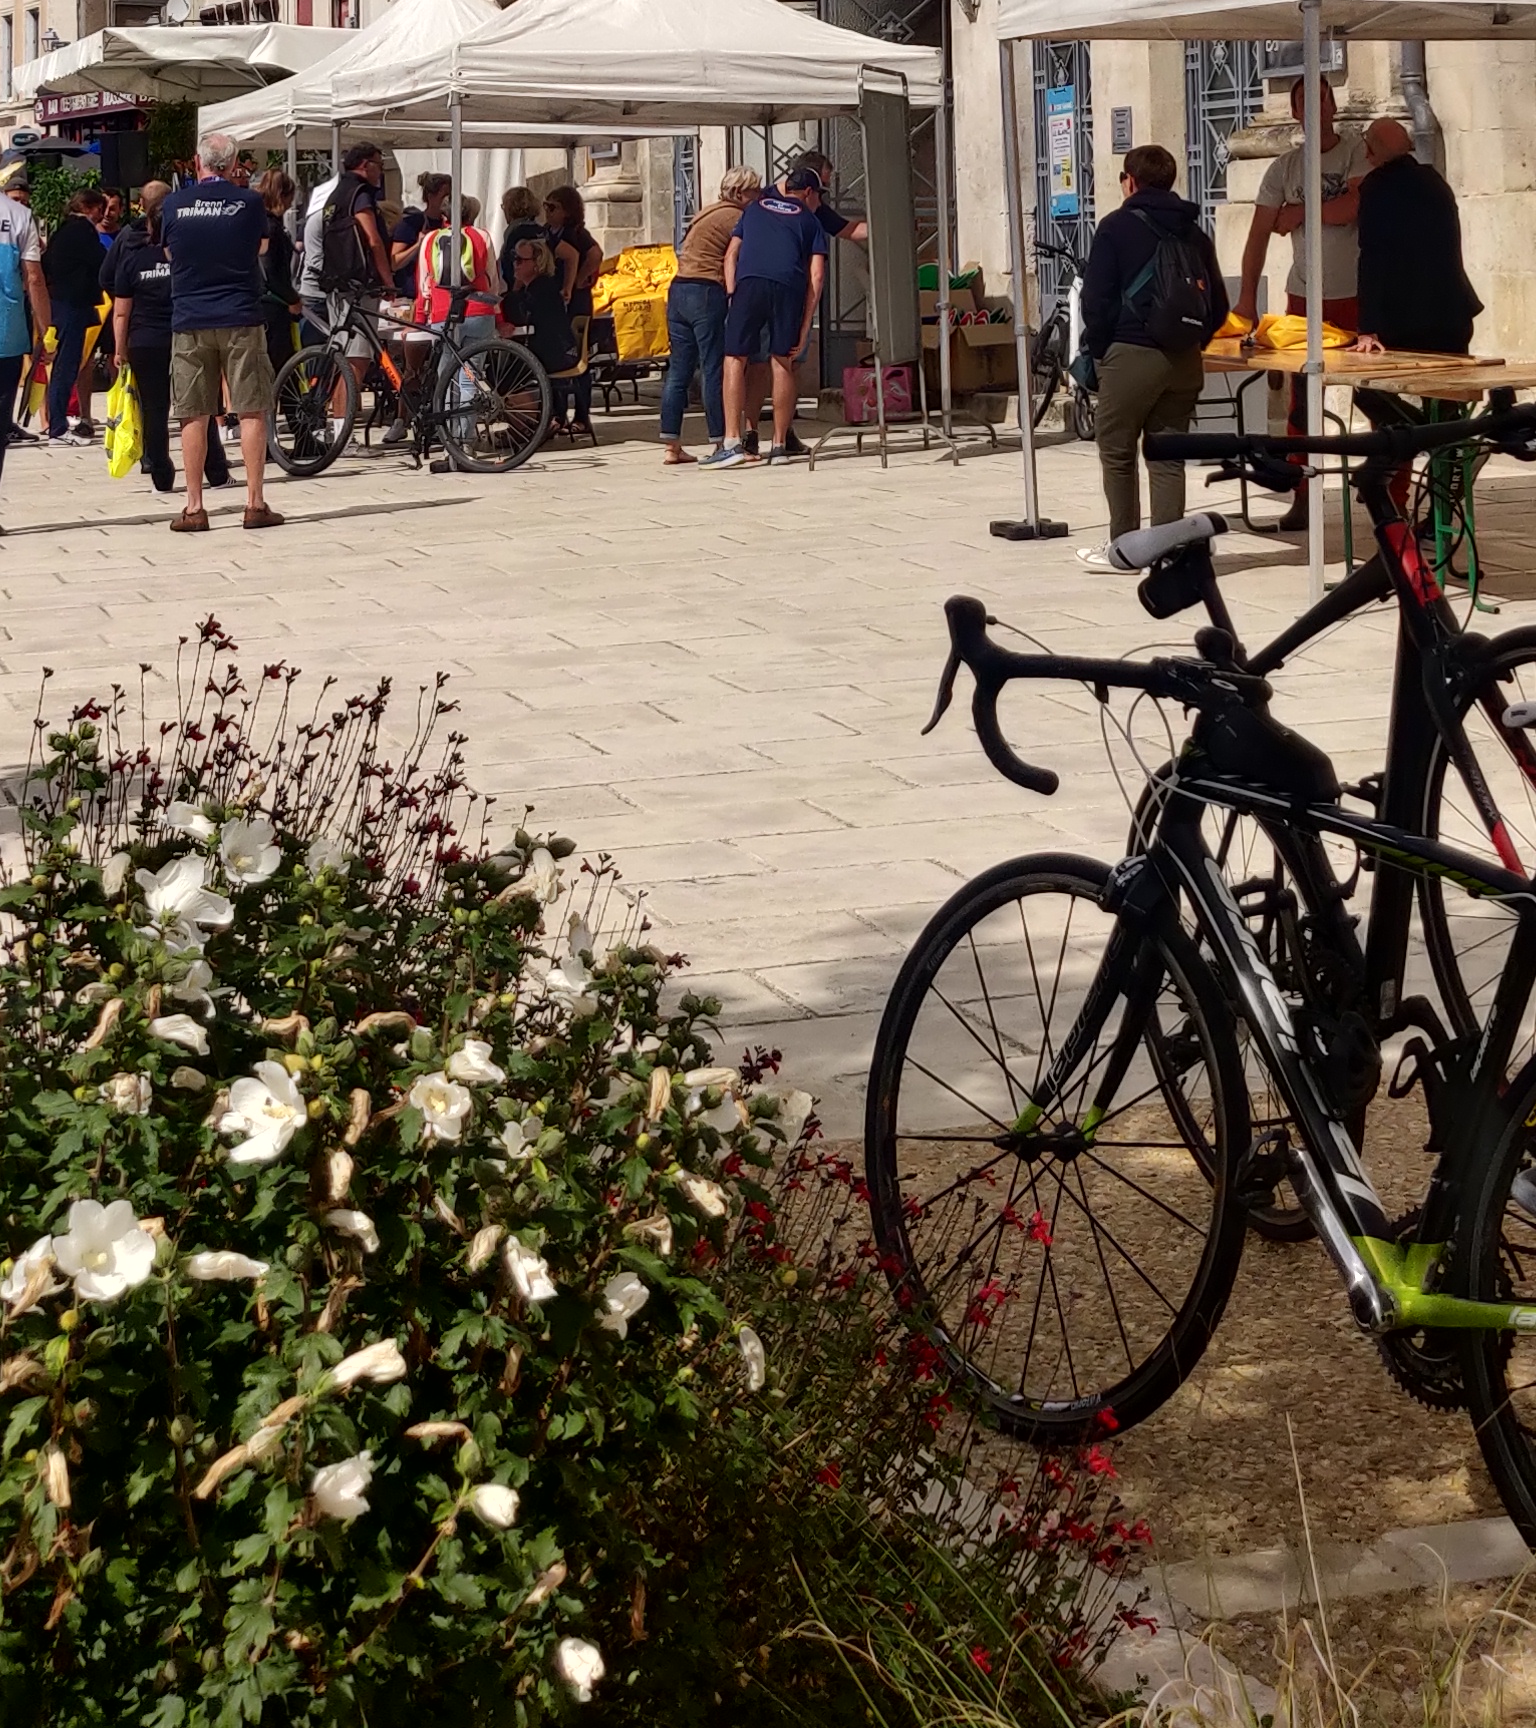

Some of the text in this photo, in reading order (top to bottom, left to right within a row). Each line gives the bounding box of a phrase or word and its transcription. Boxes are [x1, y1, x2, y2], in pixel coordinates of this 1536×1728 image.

[194, 198, 226, 208] Brenn'
[176, 205, 222, 219] TRIMAN
[140, 268, 170, 281] TRIMA
